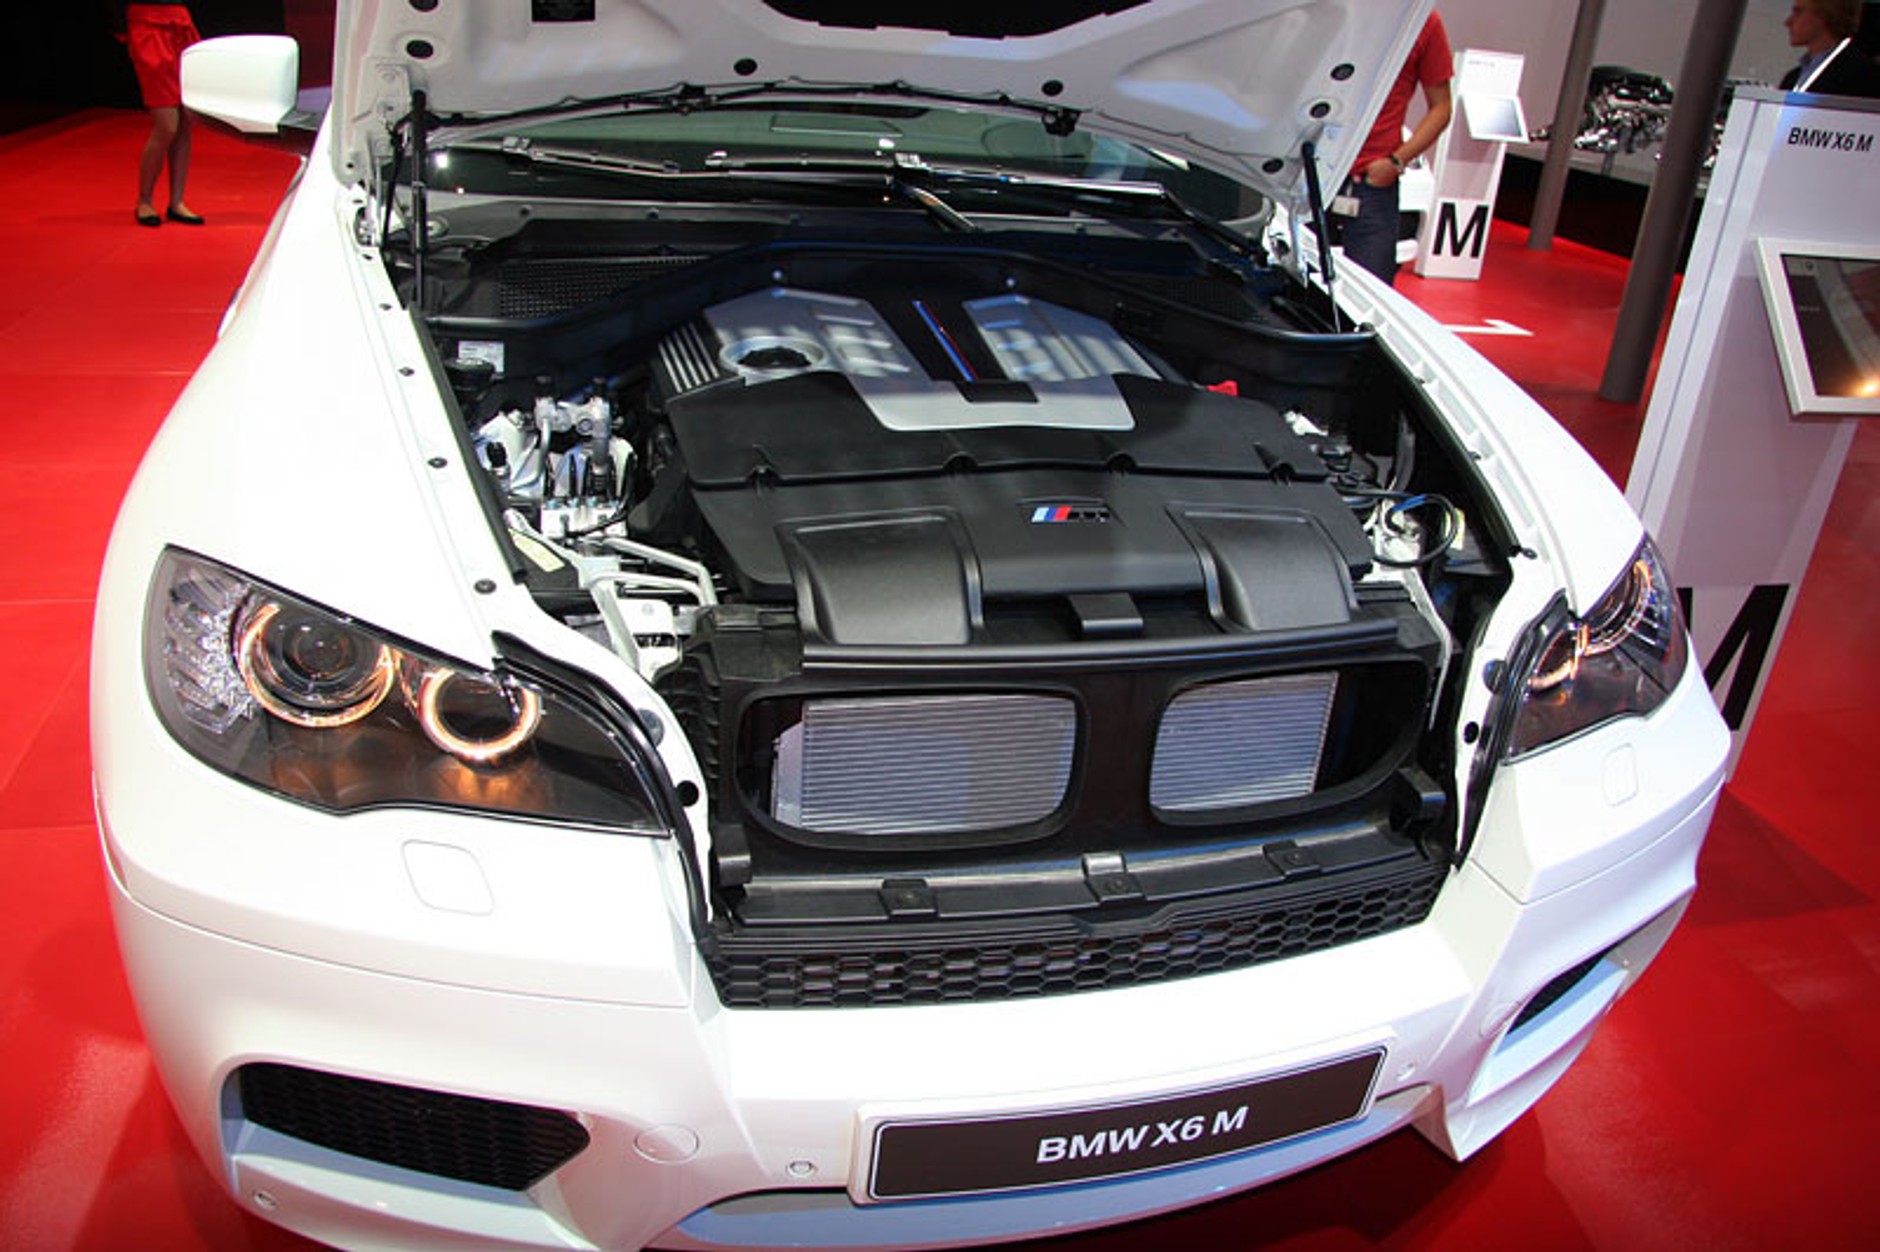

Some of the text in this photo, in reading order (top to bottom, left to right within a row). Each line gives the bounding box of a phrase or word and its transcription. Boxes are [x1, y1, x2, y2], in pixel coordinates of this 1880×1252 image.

[1788, 127, 1874, 152] BMW X6 M
[1432, 202, 1489, 259] M
[1036, 1106, 1249, 1163] BMW X6 M
